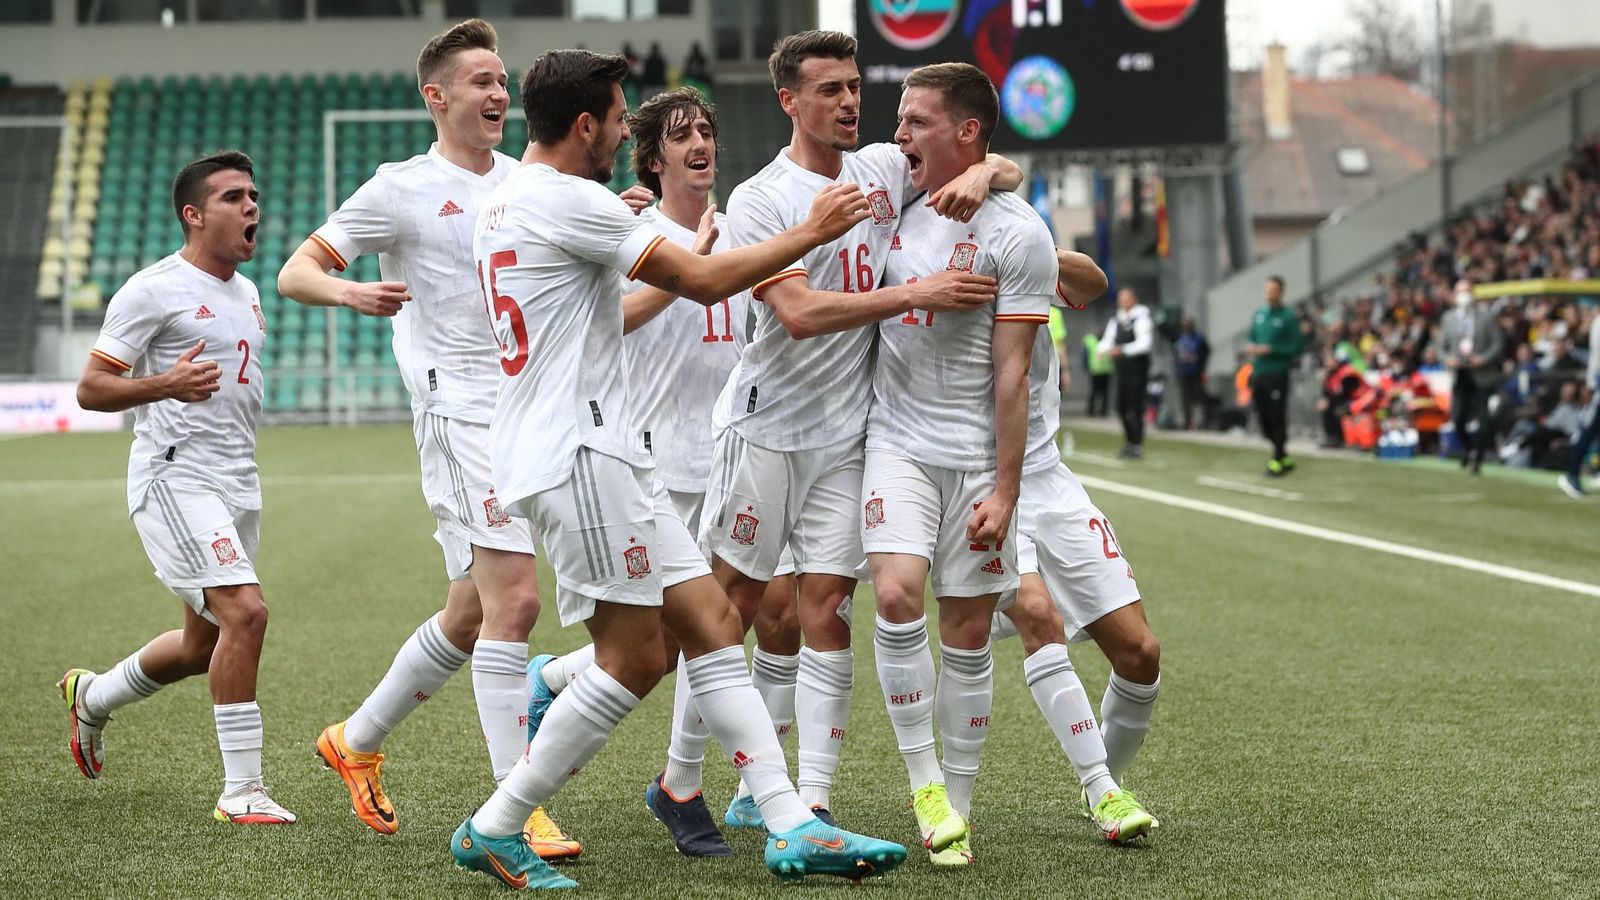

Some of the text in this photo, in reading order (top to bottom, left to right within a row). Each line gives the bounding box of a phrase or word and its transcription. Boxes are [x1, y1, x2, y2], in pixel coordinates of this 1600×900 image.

[438, 208, 464, 217] adidas
[839, 243, 873, 293] 16
[477, 250, 528, 376] 15
[702, 298, 733, 342] 11
[237, 339, 250, 385] 2
[890, 690, 922, 705] RFEF
[1070, 718, 1094, 736] RFEF
